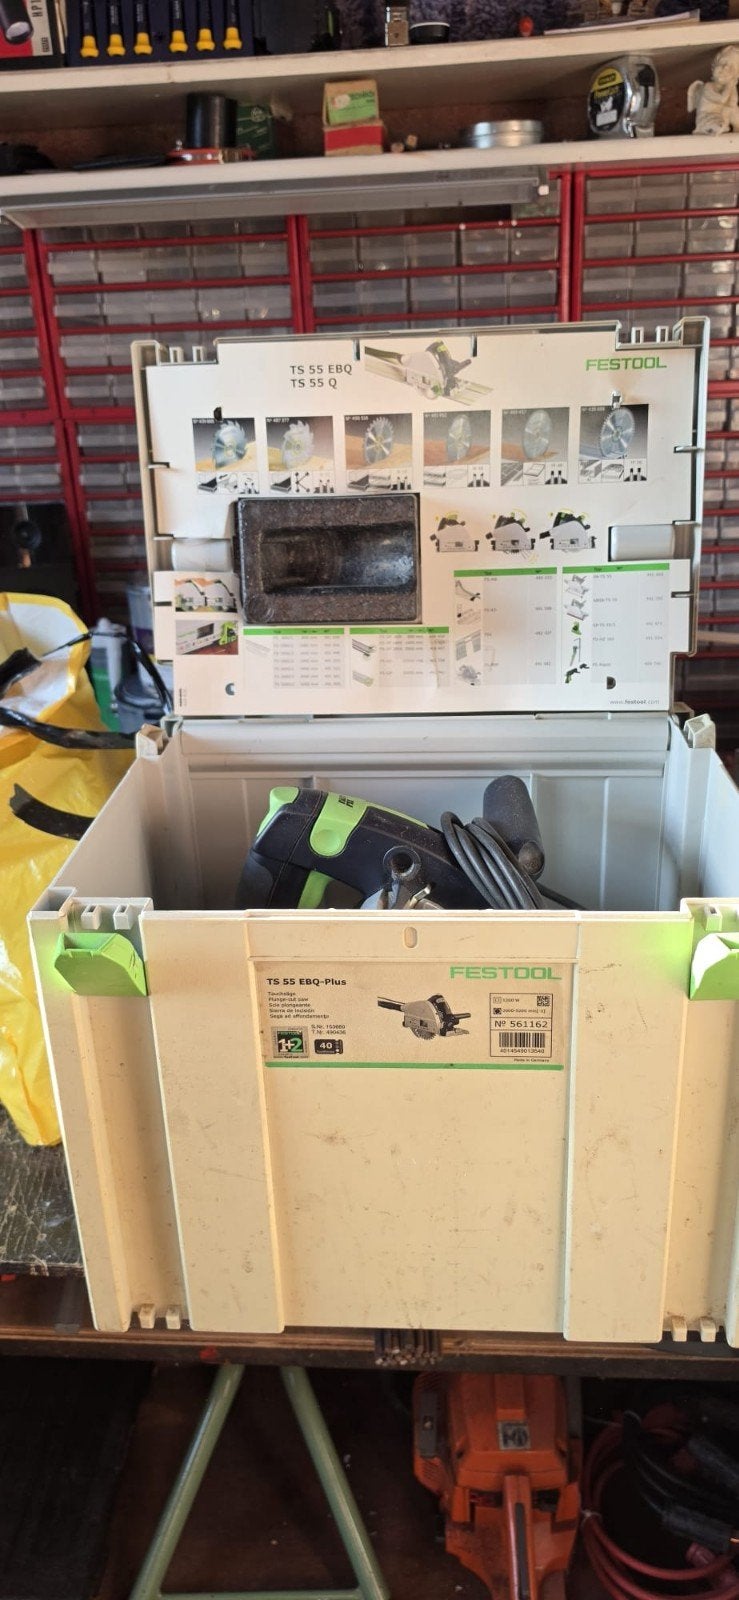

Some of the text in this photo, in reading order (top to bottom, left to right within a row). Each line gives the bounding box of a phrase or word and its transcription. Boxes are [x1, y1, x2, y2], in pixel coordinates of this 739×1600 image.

[585, 356, 667, 371] FESTOOL
[289, 364, 352, 376] TS 55 EBQ
[290, 377, 337, 389] TS 55 Q
[450, 966, 562, 980] FESTOOL
[267, 978, 347, 987] TS 55 EBQ-Plus
[510, 1020, 548, 1028] 561162
